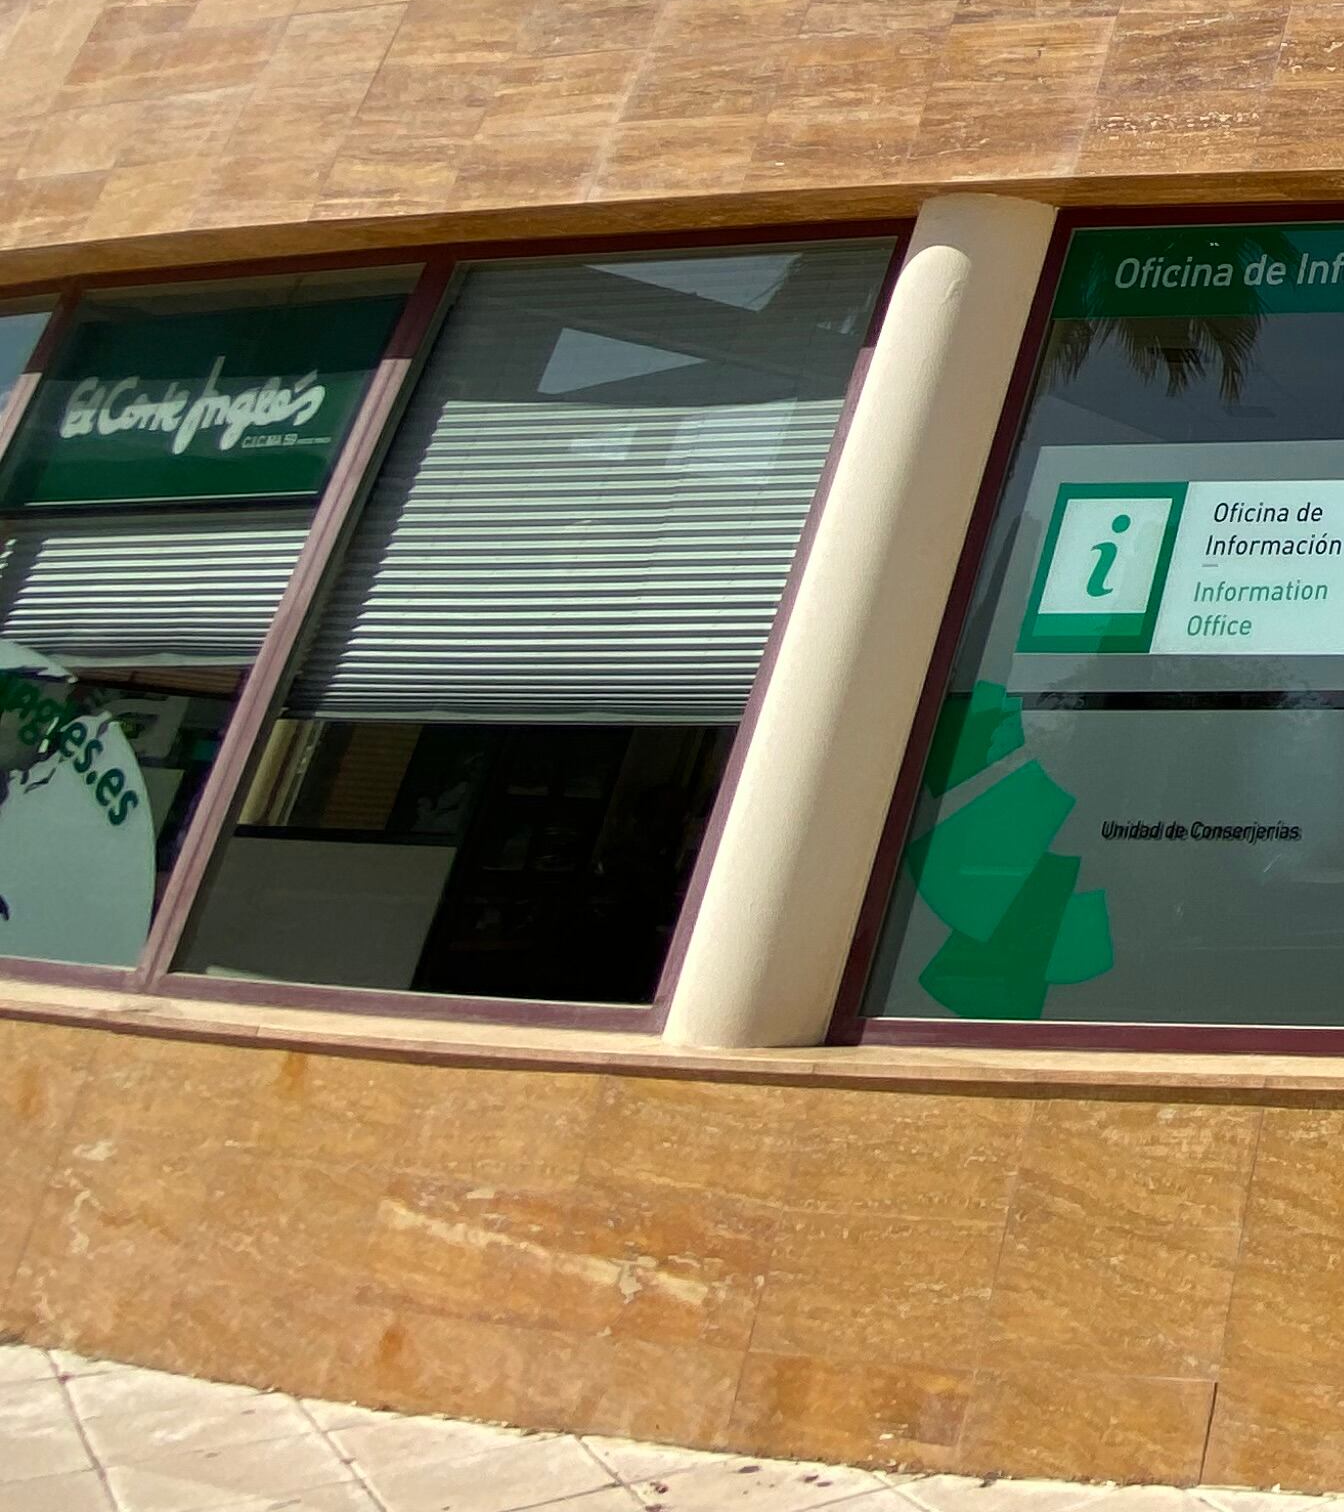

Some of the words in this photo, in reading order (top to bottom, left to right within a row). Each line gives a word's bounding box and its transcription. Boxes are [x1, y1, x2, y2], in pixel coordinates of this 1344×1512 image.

[1114, 255, 1233, 288] Oficina
[1244, 254, 1287, 286] de
[1213, 502, 1289, 523] Oficina
[1296, 502, 1323, 522] de
[1205, 533, 1342, 556] Información
[1193, 580, 1329, 602] Information
[1187, 615, 1252, 637] Office
